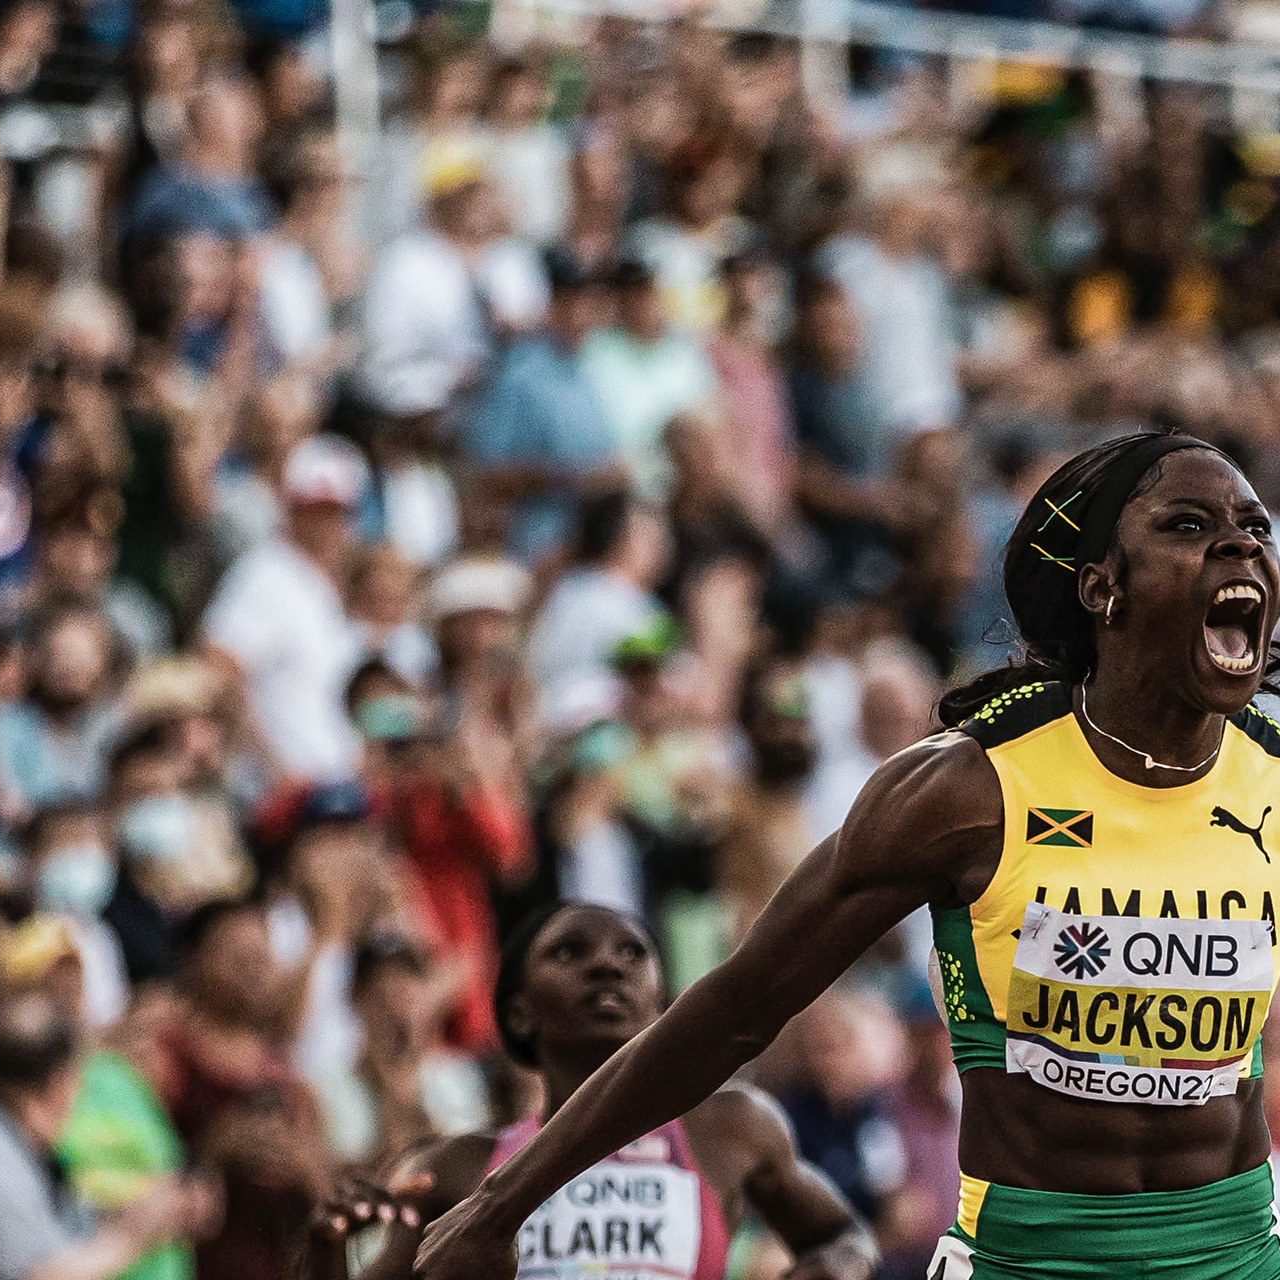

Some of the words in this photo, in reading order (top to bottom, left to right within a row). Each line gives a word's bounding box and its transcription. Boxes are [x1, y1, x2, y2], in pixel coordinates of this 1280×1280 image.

[1122, 931, 1239, 978] QNB
[1022, 984, 1256, 1052] JACKSON
[1043, 1057, 1215, 1100] OREGON22
